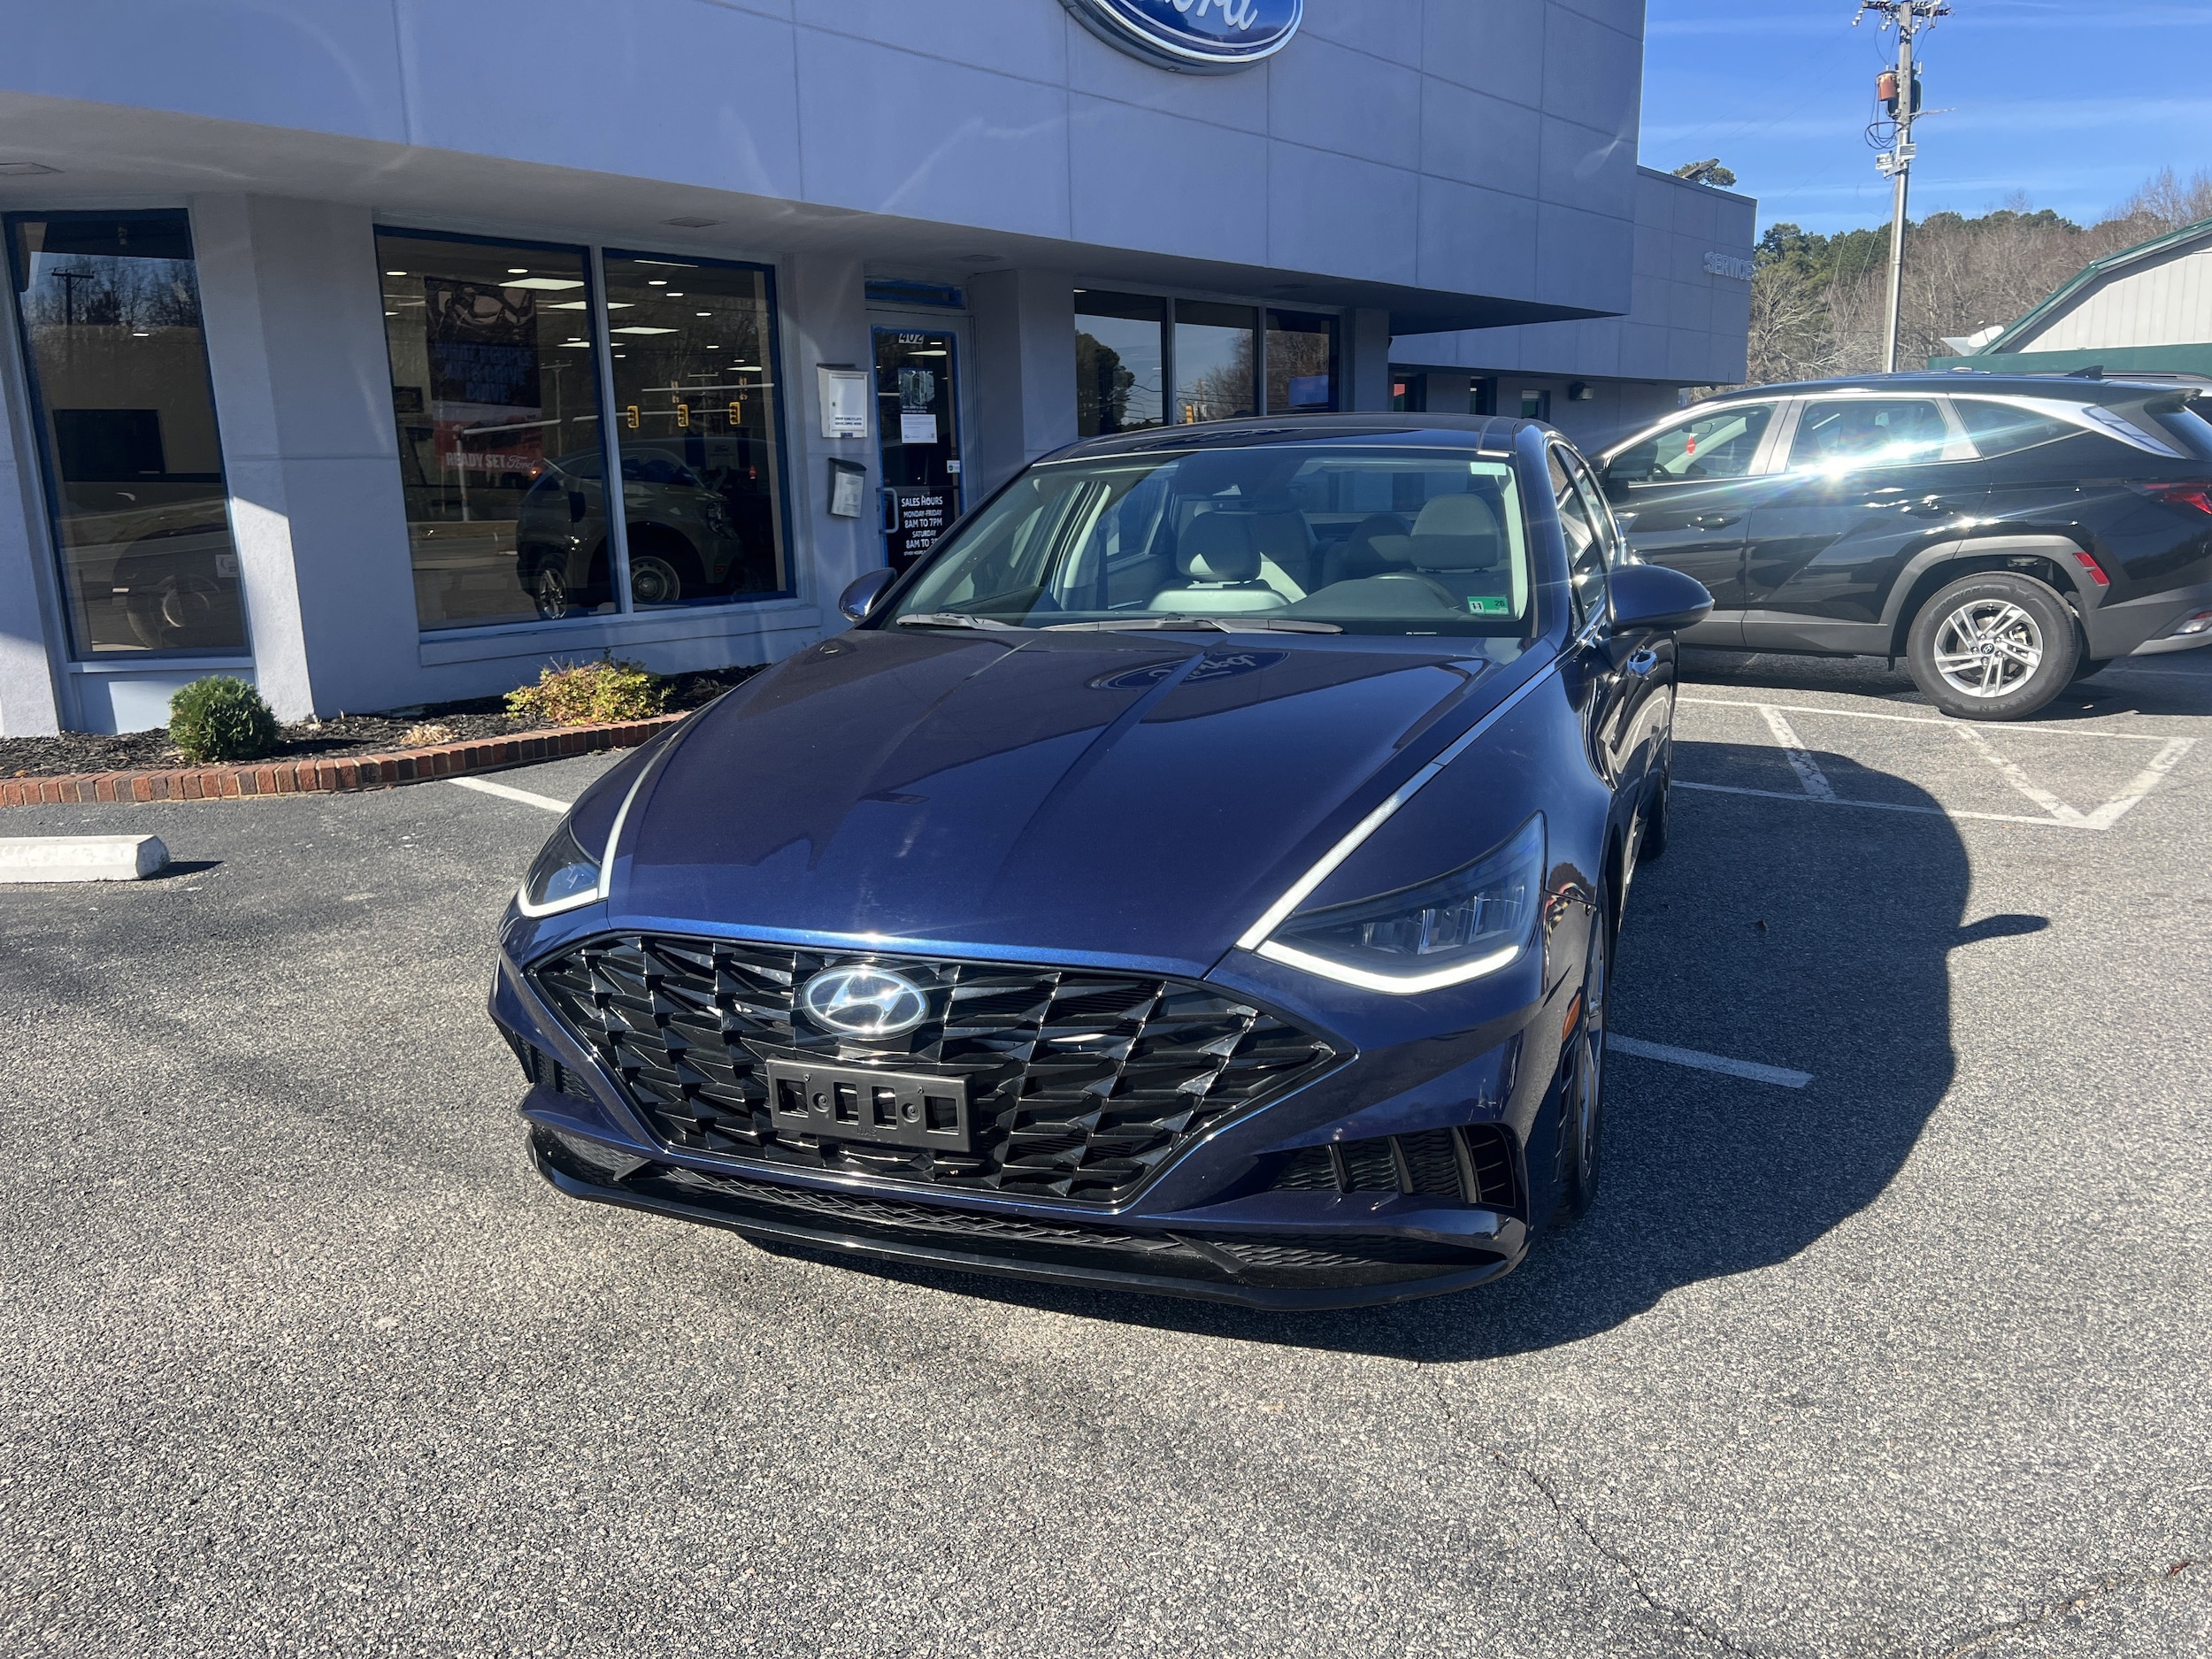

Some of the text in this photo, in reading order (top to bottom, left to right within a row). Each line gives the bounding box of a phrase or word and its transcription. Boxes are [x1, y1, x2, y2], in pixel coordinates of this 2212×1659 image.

[1705, 250, 1753, 281] SERVICE
[900, 333, 923, 343] 402
[445, 452, 538, 470] READY SET Ford
[901, 495, 943, 507] SALES HOURS
[904, 518, 942, 528] 8AM TO 7PM
[906, 539, 920, 549] 8AM
[921, 539, 930, 548] TO
